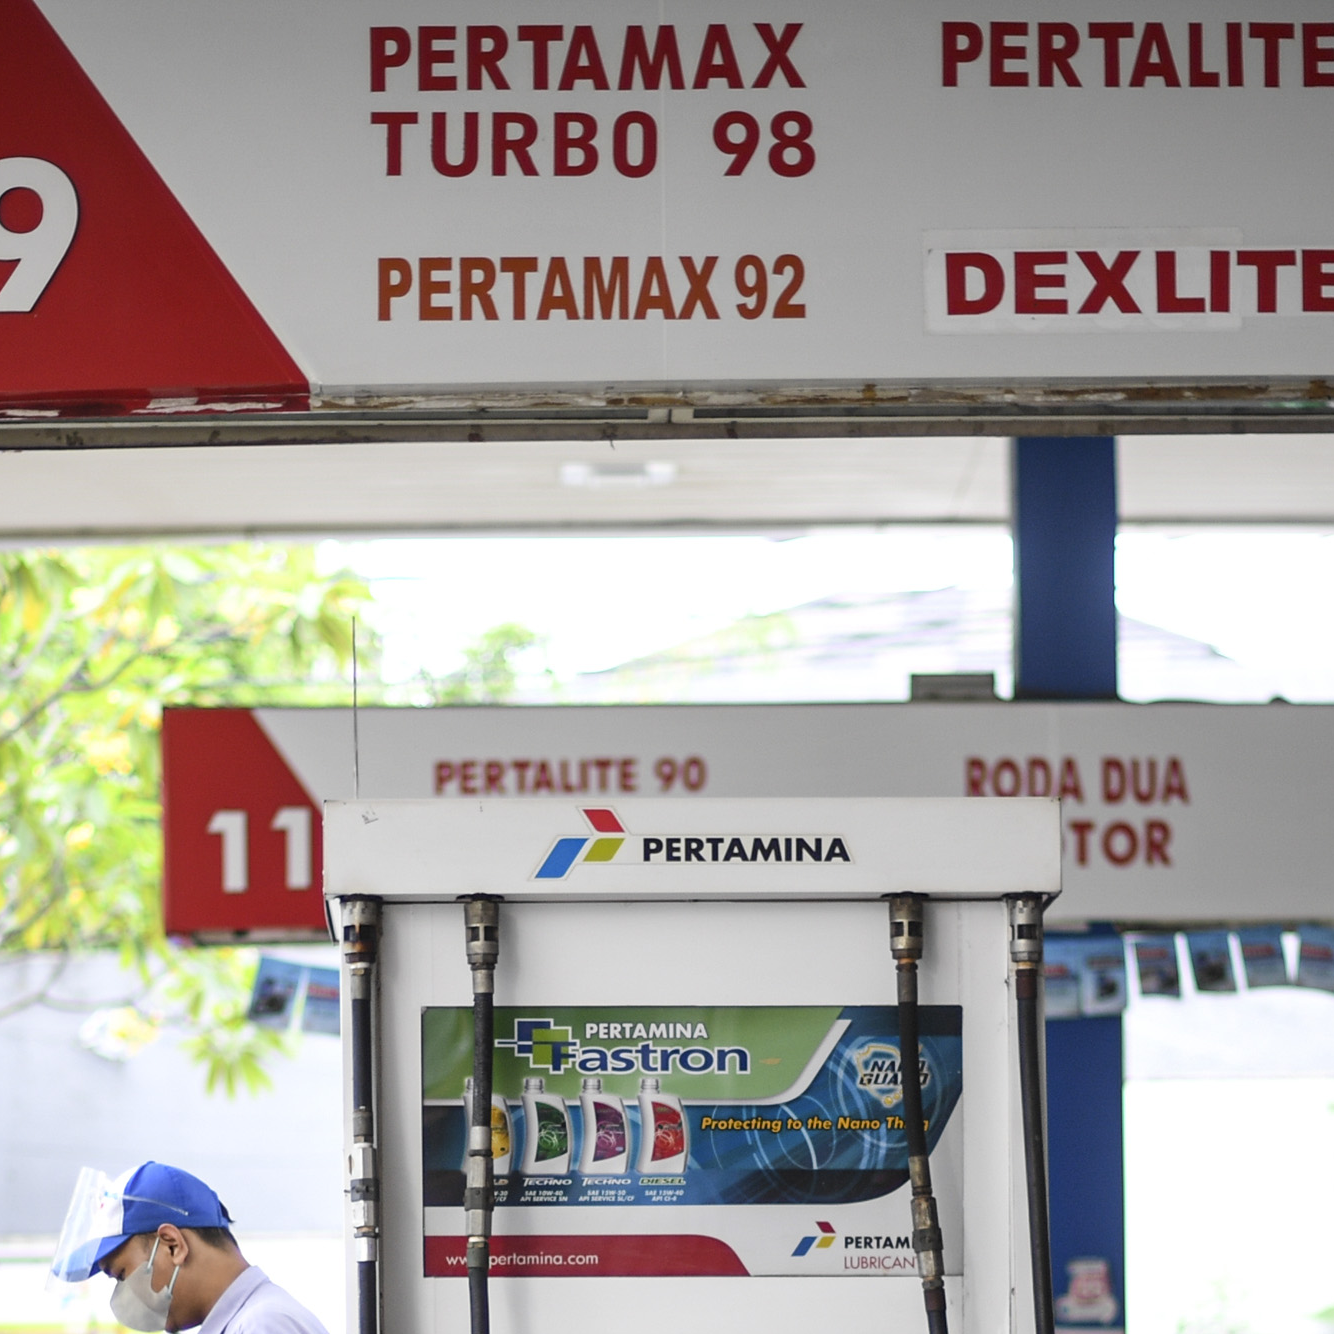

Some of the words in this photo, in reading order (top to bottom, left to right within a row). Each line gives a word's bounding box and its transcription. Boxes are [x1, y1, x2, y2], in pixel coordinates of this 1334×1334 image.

[369, 22, 807, 93] PERTAMAX
[369, 111, 661, 178] TURBO
[712, 111, 816, 178] 98
[377, 255, 717, 322] PERTAMAX
[735, 254, 807, 321] 92
[434, 758, 642, 797] PERTALITE
[653, 757, 708, 792] 90
[966, 756, 1082, 800] RODA
[1101, 756, 1189, 803] DUA
[207, 809, 312, 893] 11
[643, 837, 850, 864] PERTAMINA
[586, 1023, 708, 1038] PERTAMINA
[550, 1041, 751, 1075] Fastron
[871, 1060, 928, 1073] NAO
[858, 1073, 929, 1086] GUAD
[701, 1117, 782, 1133] Protecting
[787, 1118, 802, 1130] to
[807, 1117, 832, 1130] the
[837, 1118, 880, 1130] Nano
[886, 1117, 929, 1132] Thg
[523, 1177, 572, 1186] TECHNO
[582, 1177, 632, 1186] TECHNO
[639, 1177, 686, 1186] DIESEL
[844, 1236, 912, 1249] PERTAM
[446, 1252, 599, 1269] wwpertamina.com
